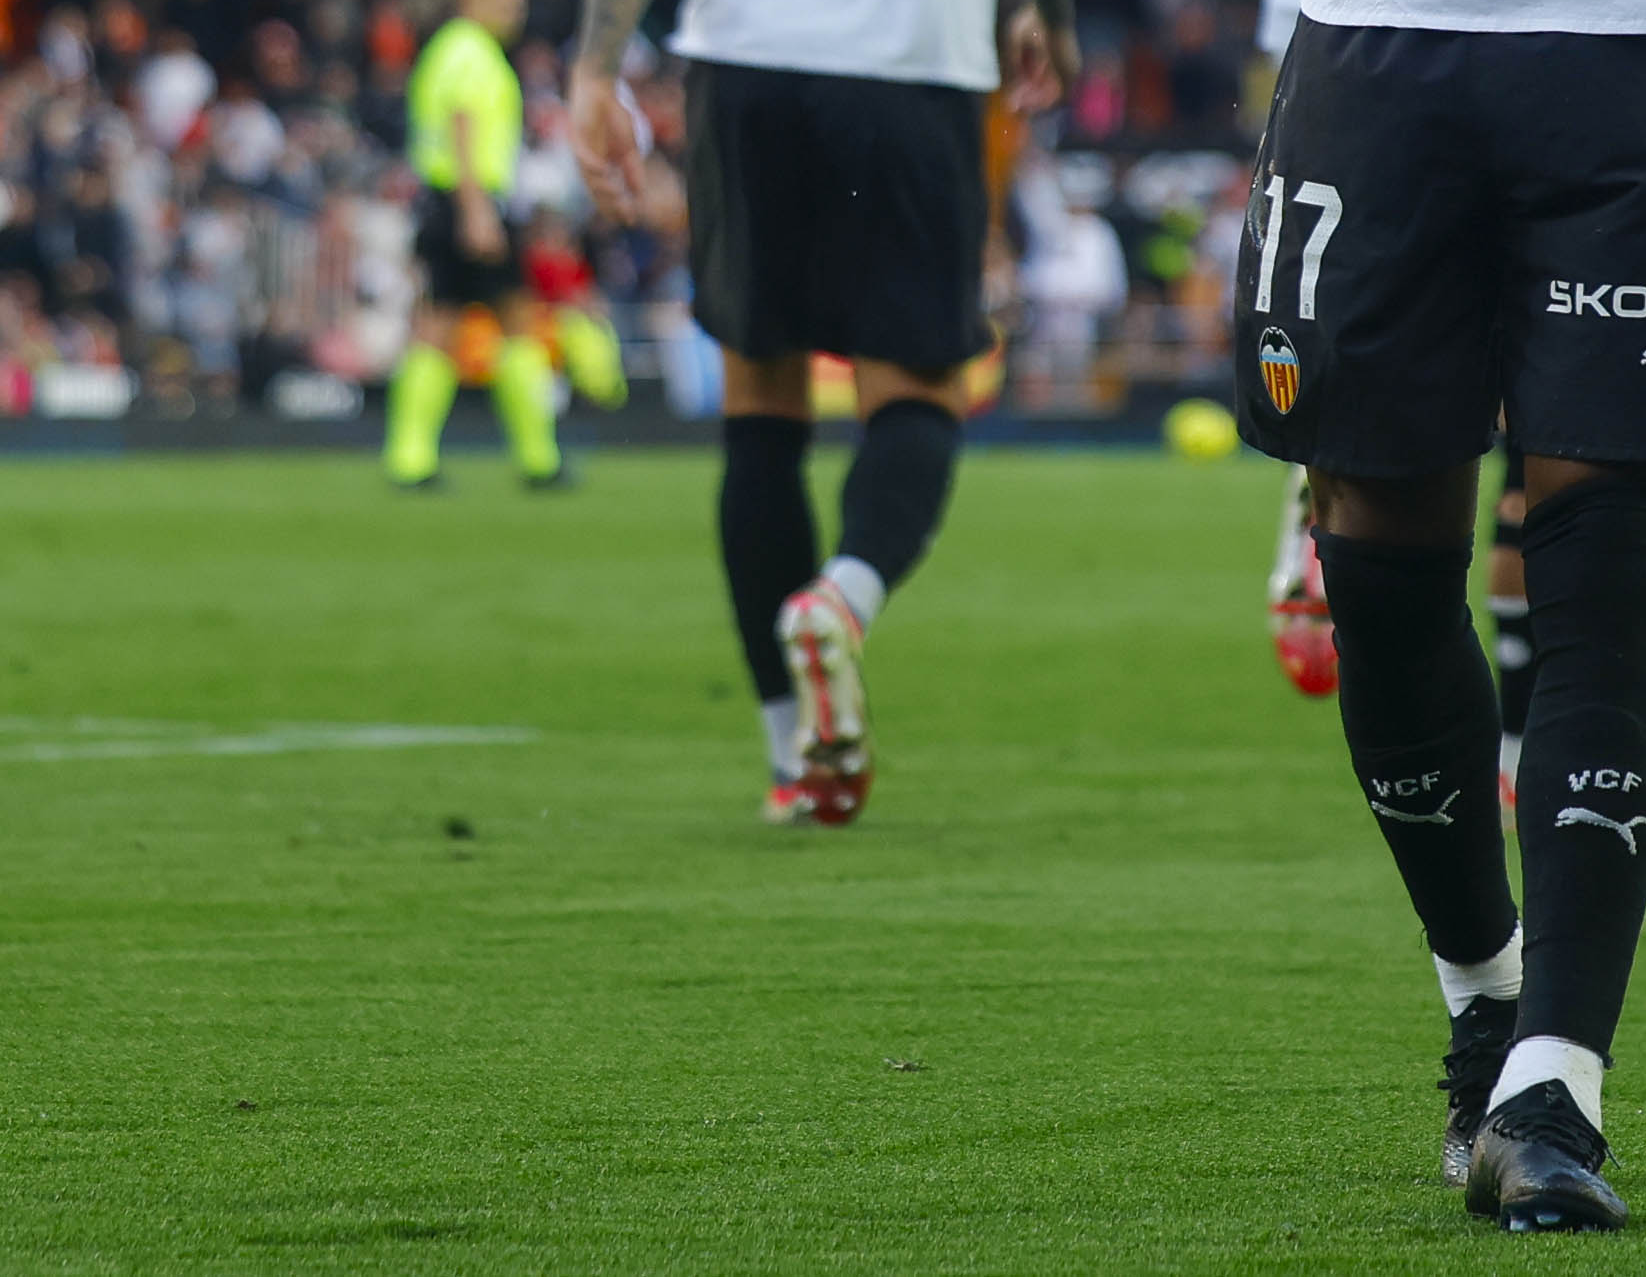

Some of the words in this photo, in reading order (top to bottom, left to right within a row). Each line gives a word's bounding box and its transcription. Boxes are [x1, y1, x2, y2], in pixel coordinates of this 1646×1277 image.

[1255, 174, 1343, 321] 17
[1371, 771, 1441, 798] VCF
[1568, 768, 1642, 793] VCF
